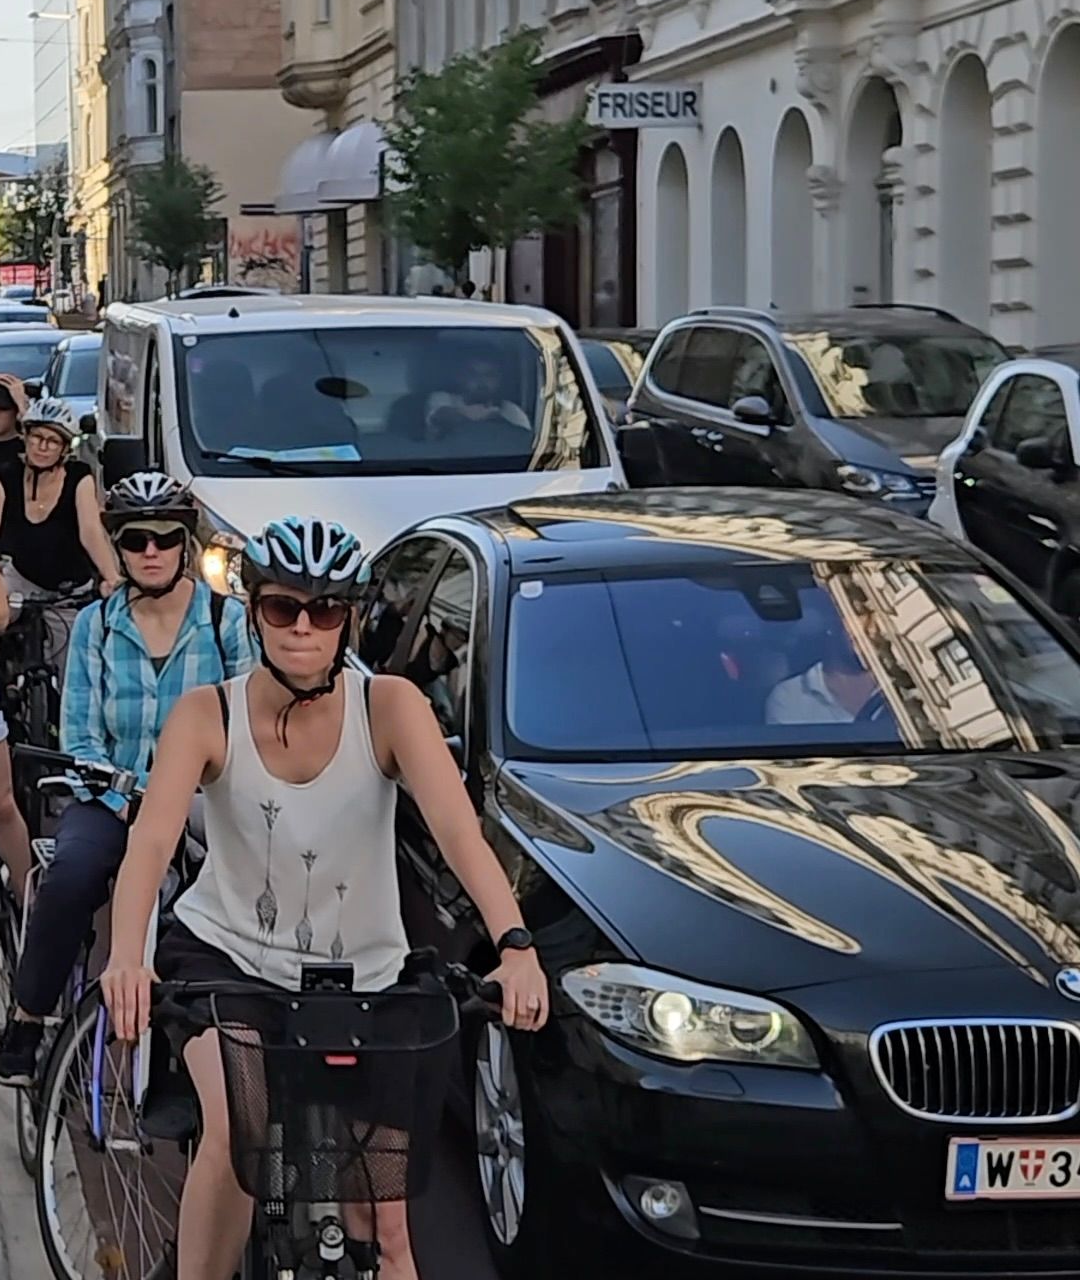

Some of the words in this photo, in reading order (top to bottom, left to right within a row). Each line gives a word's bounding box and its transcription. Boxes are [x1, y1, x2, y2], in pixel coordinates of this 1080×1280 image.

[598, 91, 698, 118] FRISEUR
[959, 1174, 972, 1188] A
[987, 1151, 1015, 1188] W
[1049, 1151, 1080, 1188] 3
